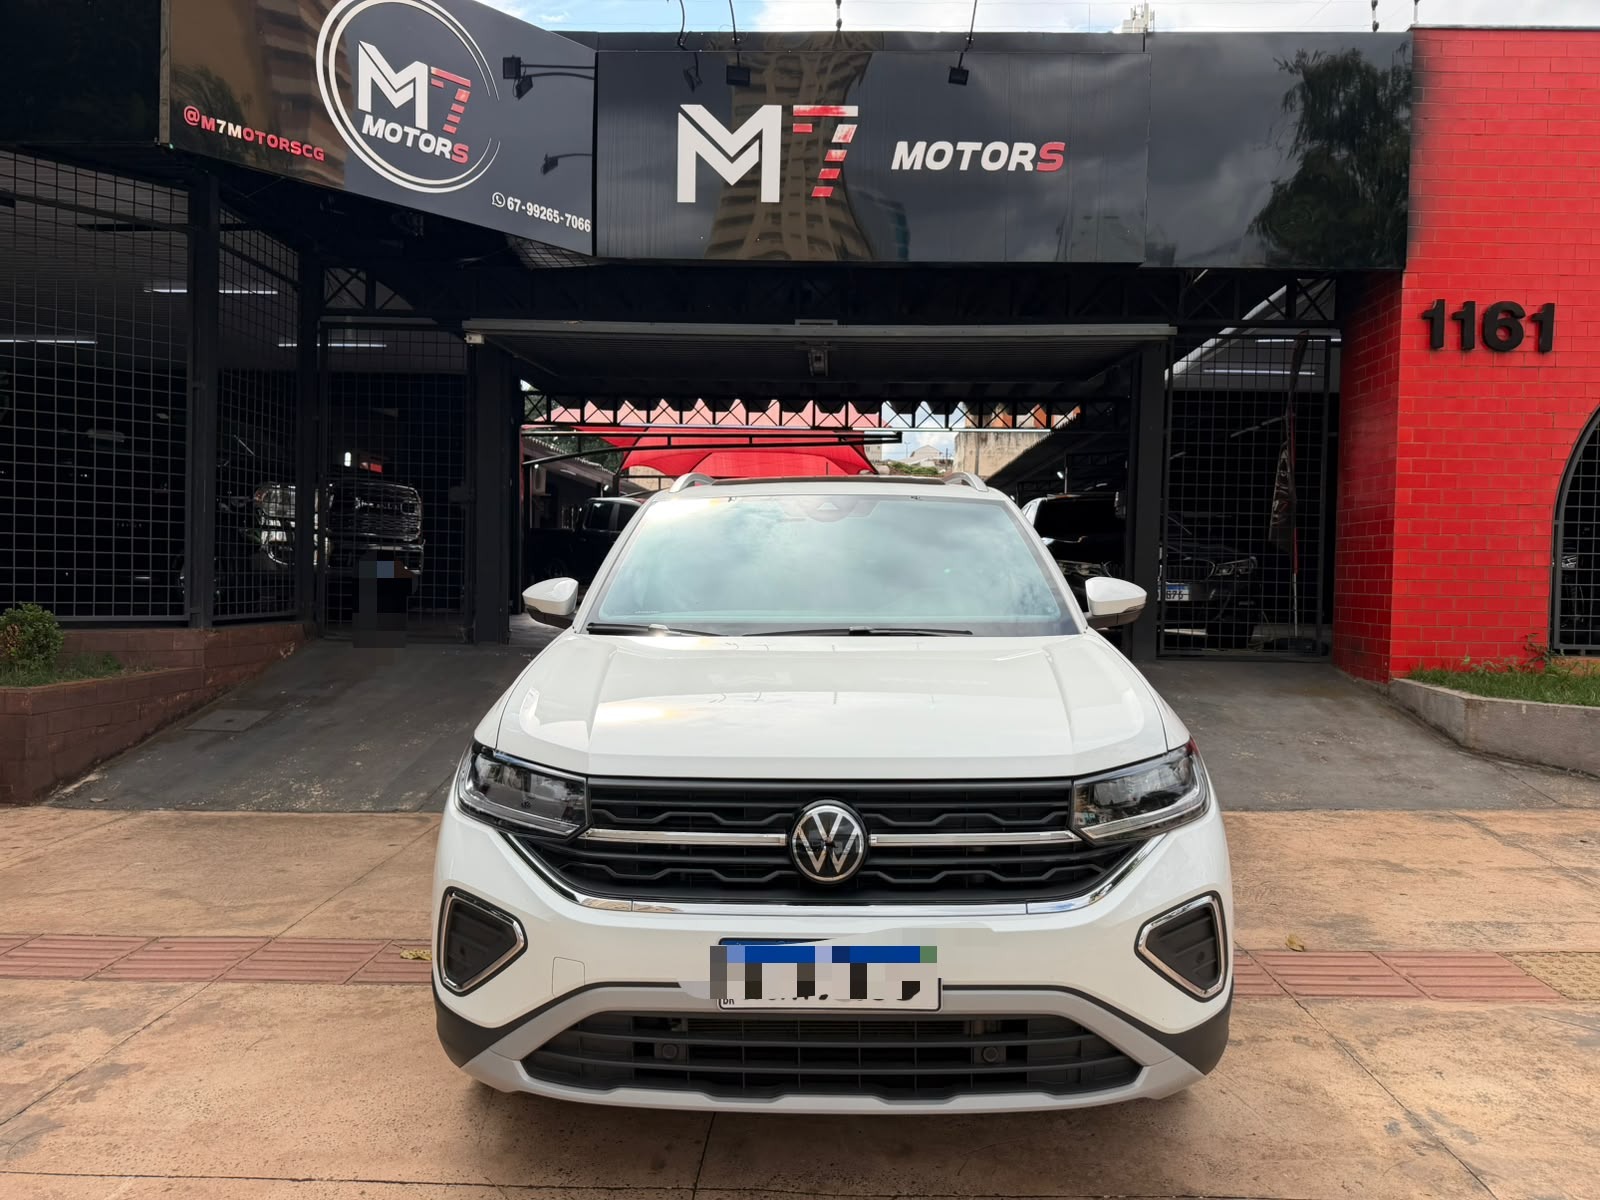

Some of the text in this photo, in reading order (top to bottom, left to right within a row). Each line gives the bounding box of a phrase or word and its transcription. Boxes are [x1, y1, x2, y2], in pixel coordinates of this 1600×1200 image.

[358, 40, 471, 132] M7
[184, 105, 325, 162] @M7MOTORSCG
[361, 113, 470, 164] MOTORS
[677, 104, 1066, 203] M7 MOTORS
[507, 196, 591, 232] 67-99265-7066
[1422, 299, 1556, 354] 1161
